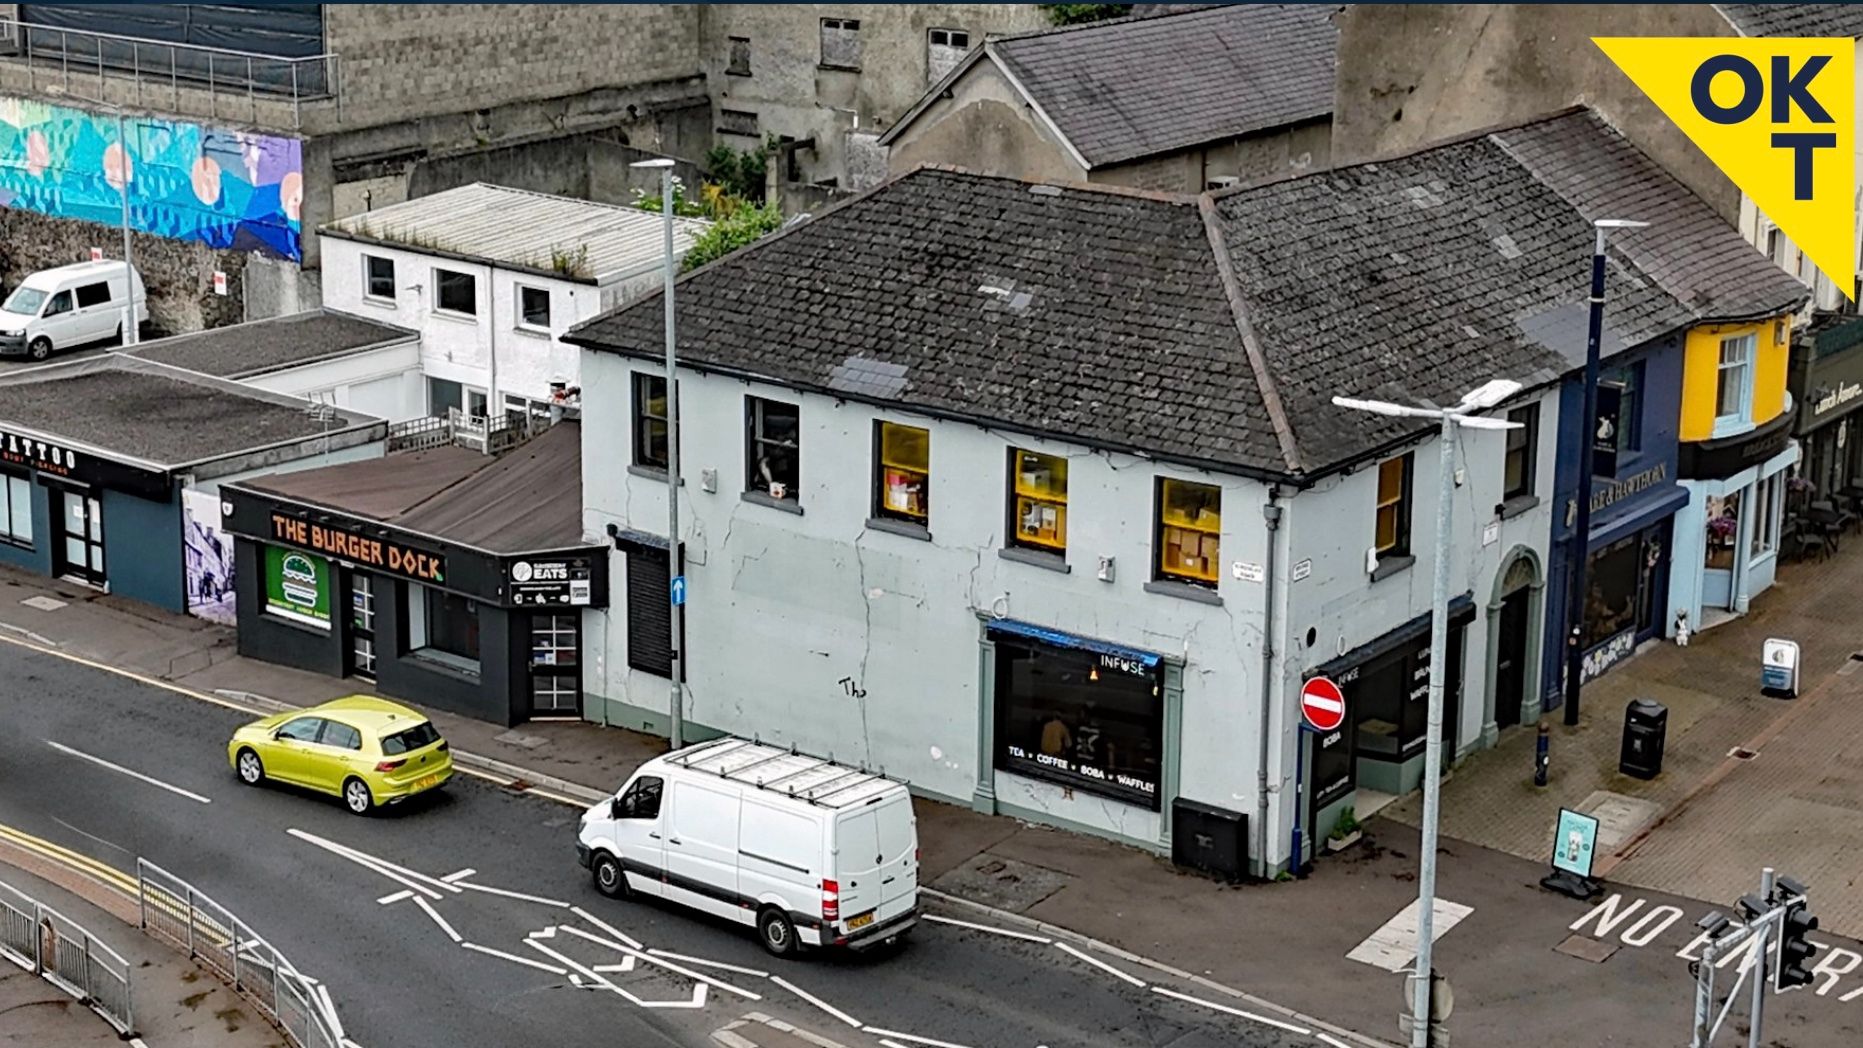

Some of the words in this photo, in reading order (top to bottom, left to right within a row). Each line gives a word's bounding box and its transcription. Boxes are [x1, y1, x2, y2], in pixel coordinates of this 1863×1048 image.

[272, 515, 308, 544] THE
[312, 526, 384, 565] BURGER
[388, 545, 443, 581] DOCK
[533, 568, 568, 579] EATS
[1101, 654, 1146, 676] INFUSE
[1008, 746, 1025, 757] TEA
[1036, 753, 1068, 769] COFFEE
[1080, 765, 1105, 780] BOBA
[1116, 774, 1155, 793] WAFFLES
[1568, 894, 1684, 947] NO
